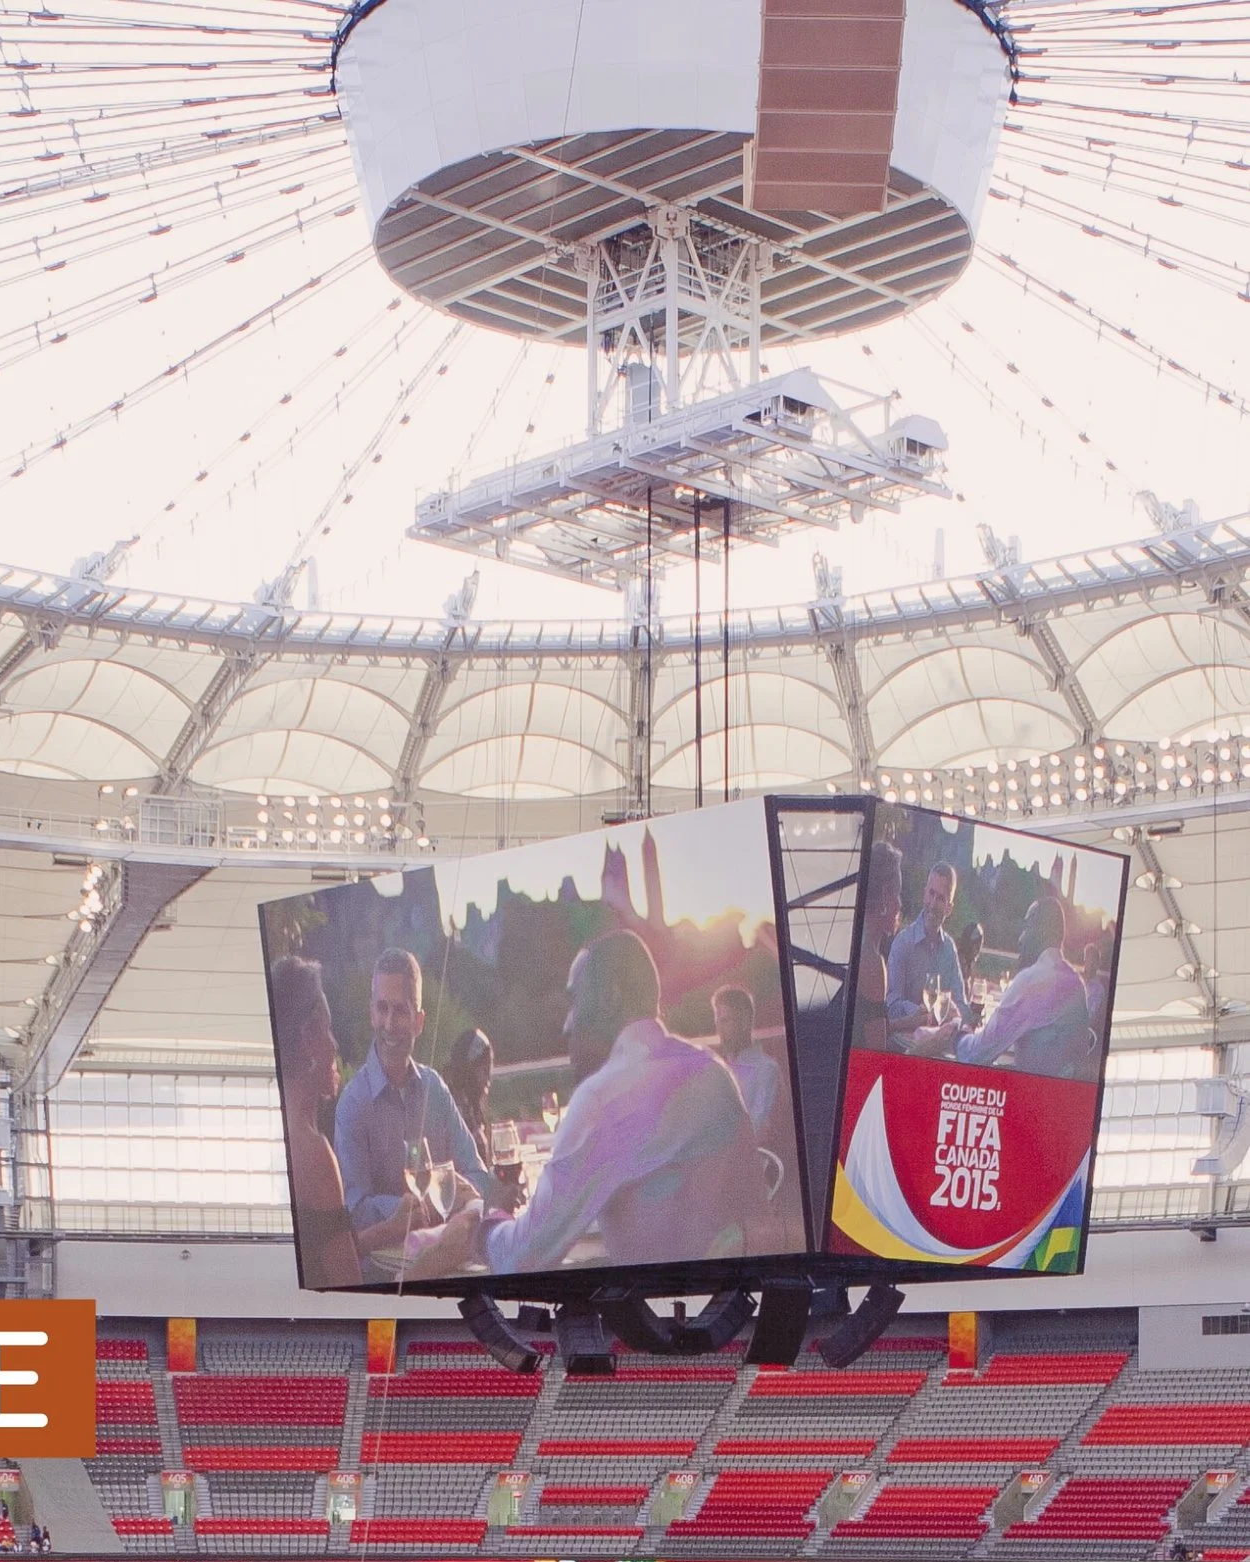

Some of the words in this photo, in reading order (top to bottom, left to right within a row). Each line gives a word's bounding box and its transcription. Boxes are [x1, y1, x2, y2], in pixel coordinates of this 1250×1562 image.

[941, 1083, 985, 1105] COUPE
[987, 1089, 1006, 1107] DU
[937, 1109, 1002, 1151] FIFA
[935, 1144, 1000, 1171] CANADA
[930, 1165, 999, 1211] 2015
[505, 1474, 524, 1484] 407
[675, 1474, 694, 1484] 408
